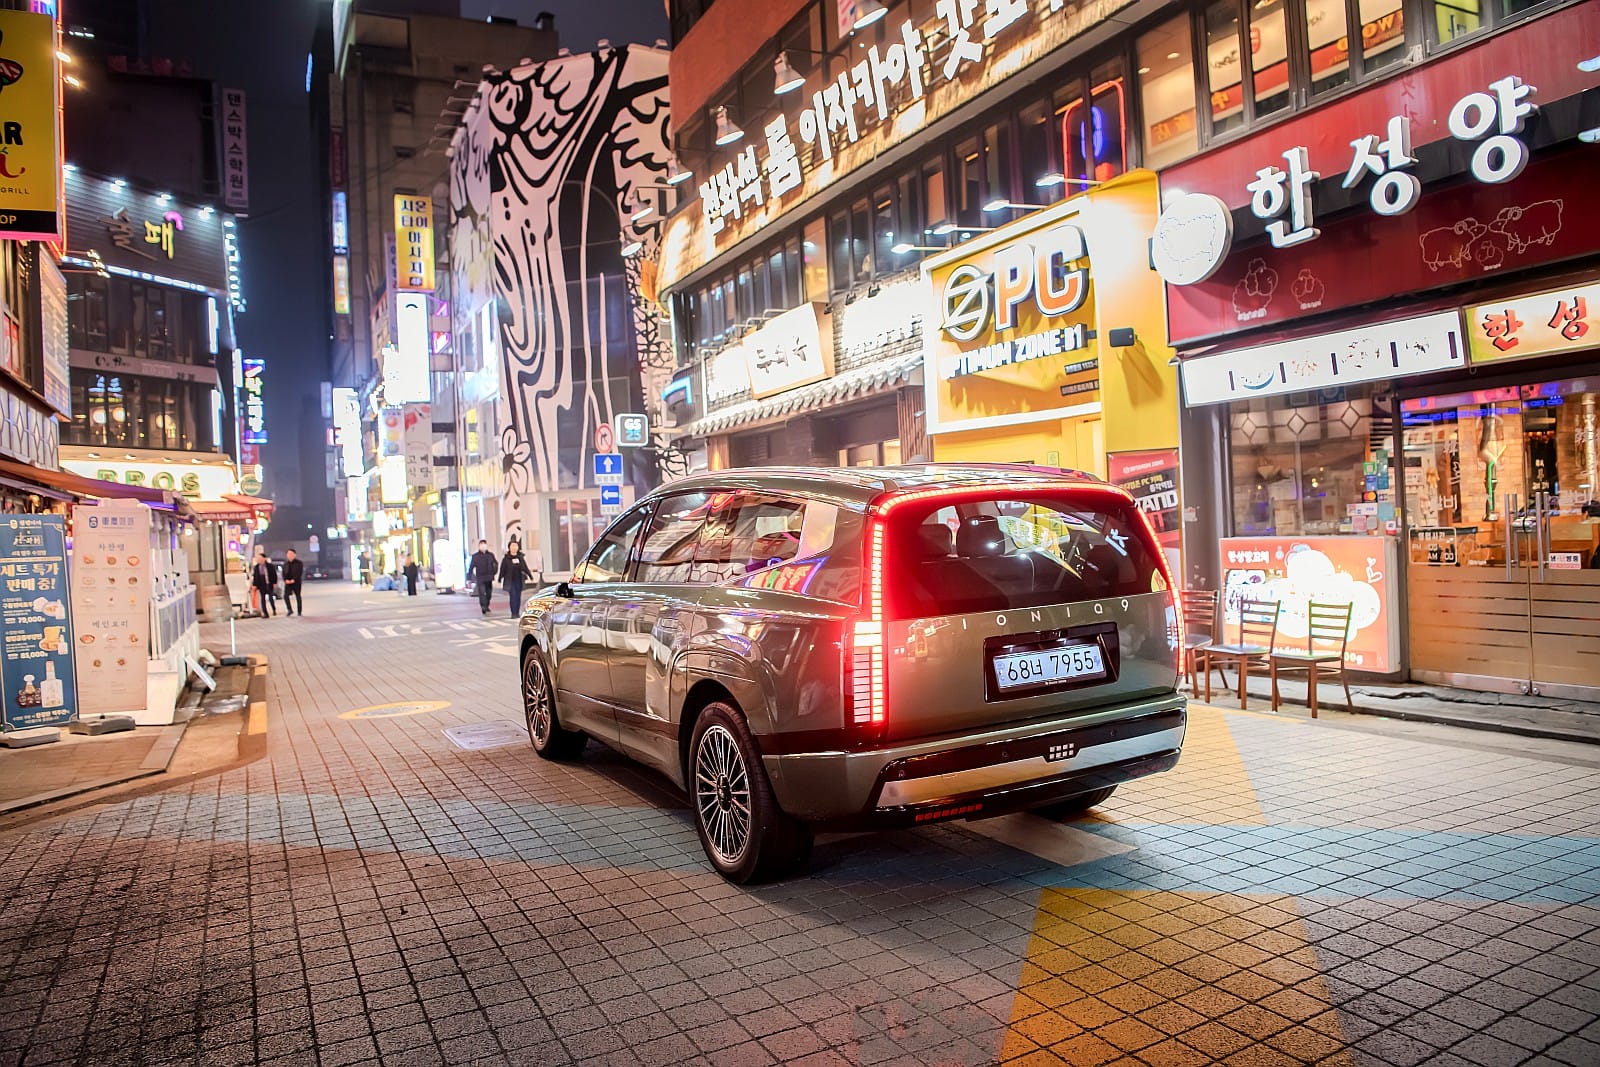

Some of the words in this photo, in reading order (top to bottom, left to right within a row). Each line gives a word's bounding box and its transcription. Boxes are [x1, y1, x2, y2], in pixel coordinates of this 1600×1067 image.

[800, 19, 925, 160] 이자카야
[0, 121, 23, 145] R
[227, 93, 243, 189] 댄스박스학원
[994, 224, 1090, 333] PC
[939, 341, 1013, 380] OPTIMUM
[1015, 329, 1062, 362] ZONE
[624, 418, 641, 430] GS
[625, 430, 641, 441] 25
[1, 564, 30, 577] 세트
[37, 577, 56, 591] 중!
[1007, 659, 1043, 681] 68너
[1049, 650, 1094, 675] 7955
